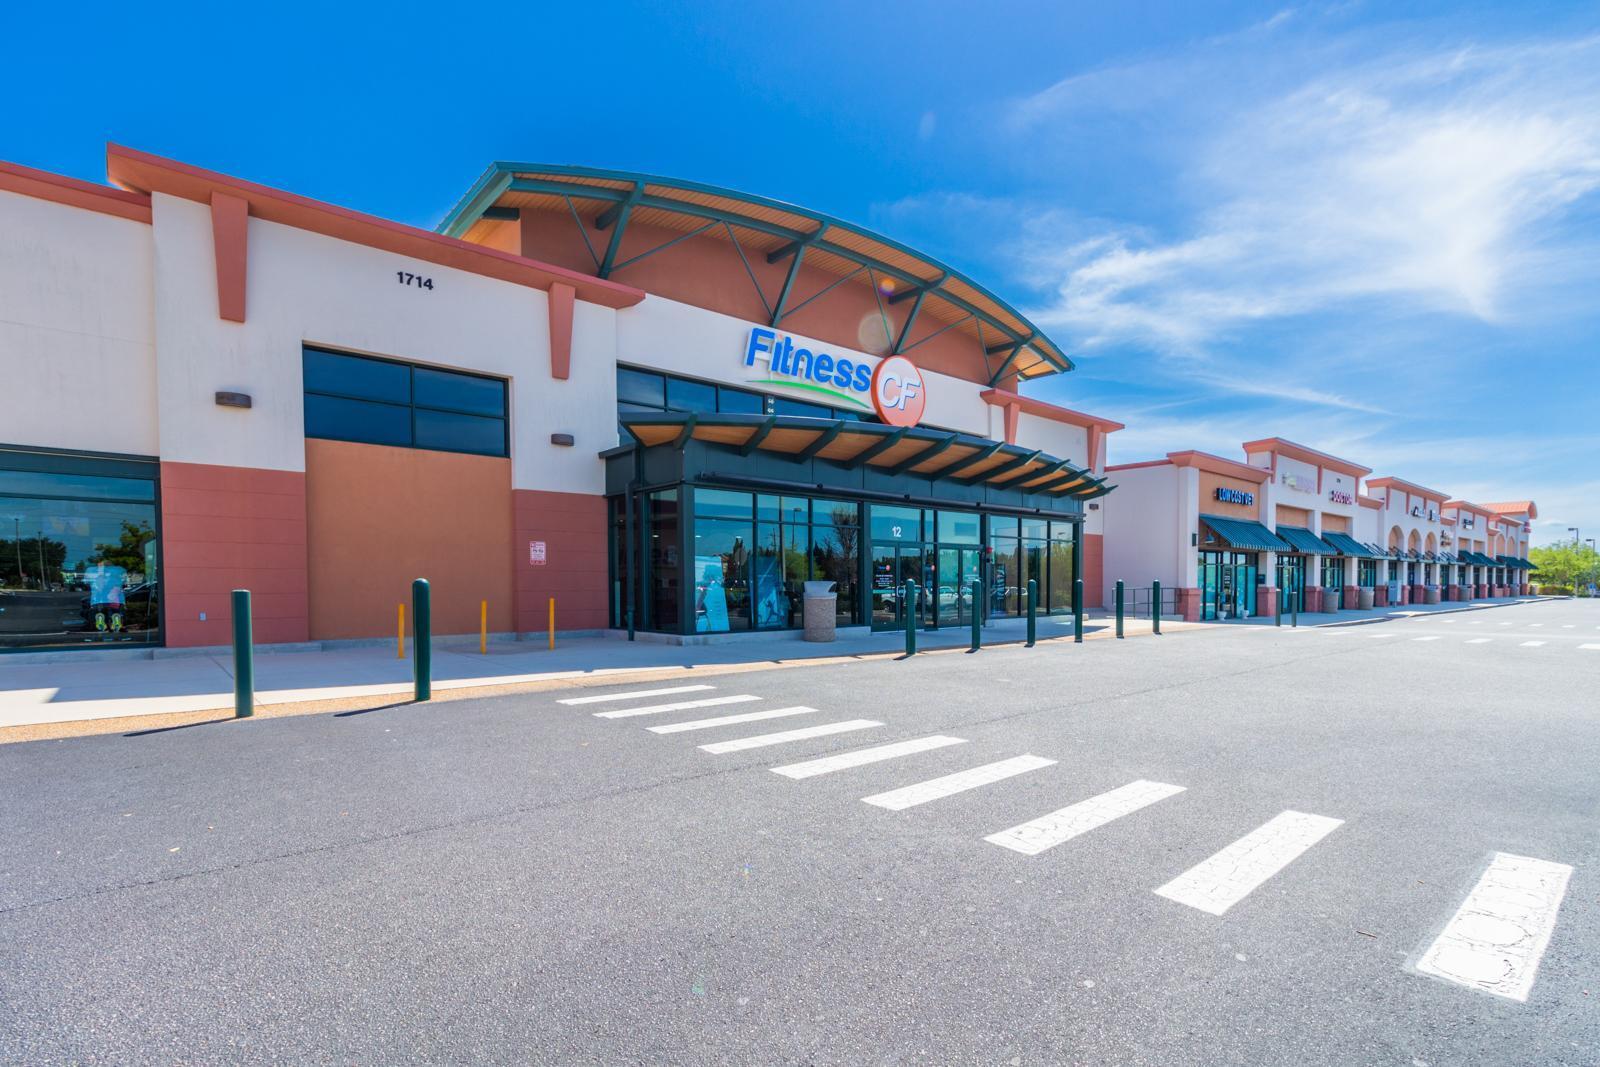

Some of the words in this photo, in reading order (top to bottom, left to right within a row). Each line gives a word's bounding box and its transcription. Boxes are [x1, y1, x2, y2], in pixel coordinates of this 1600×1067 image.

[397, 271, 434, 290] 1714
[745, 327, 872, 393] Fitness
[878, 374, 921, 411] CF
[892, 526, 902, 537] 12
